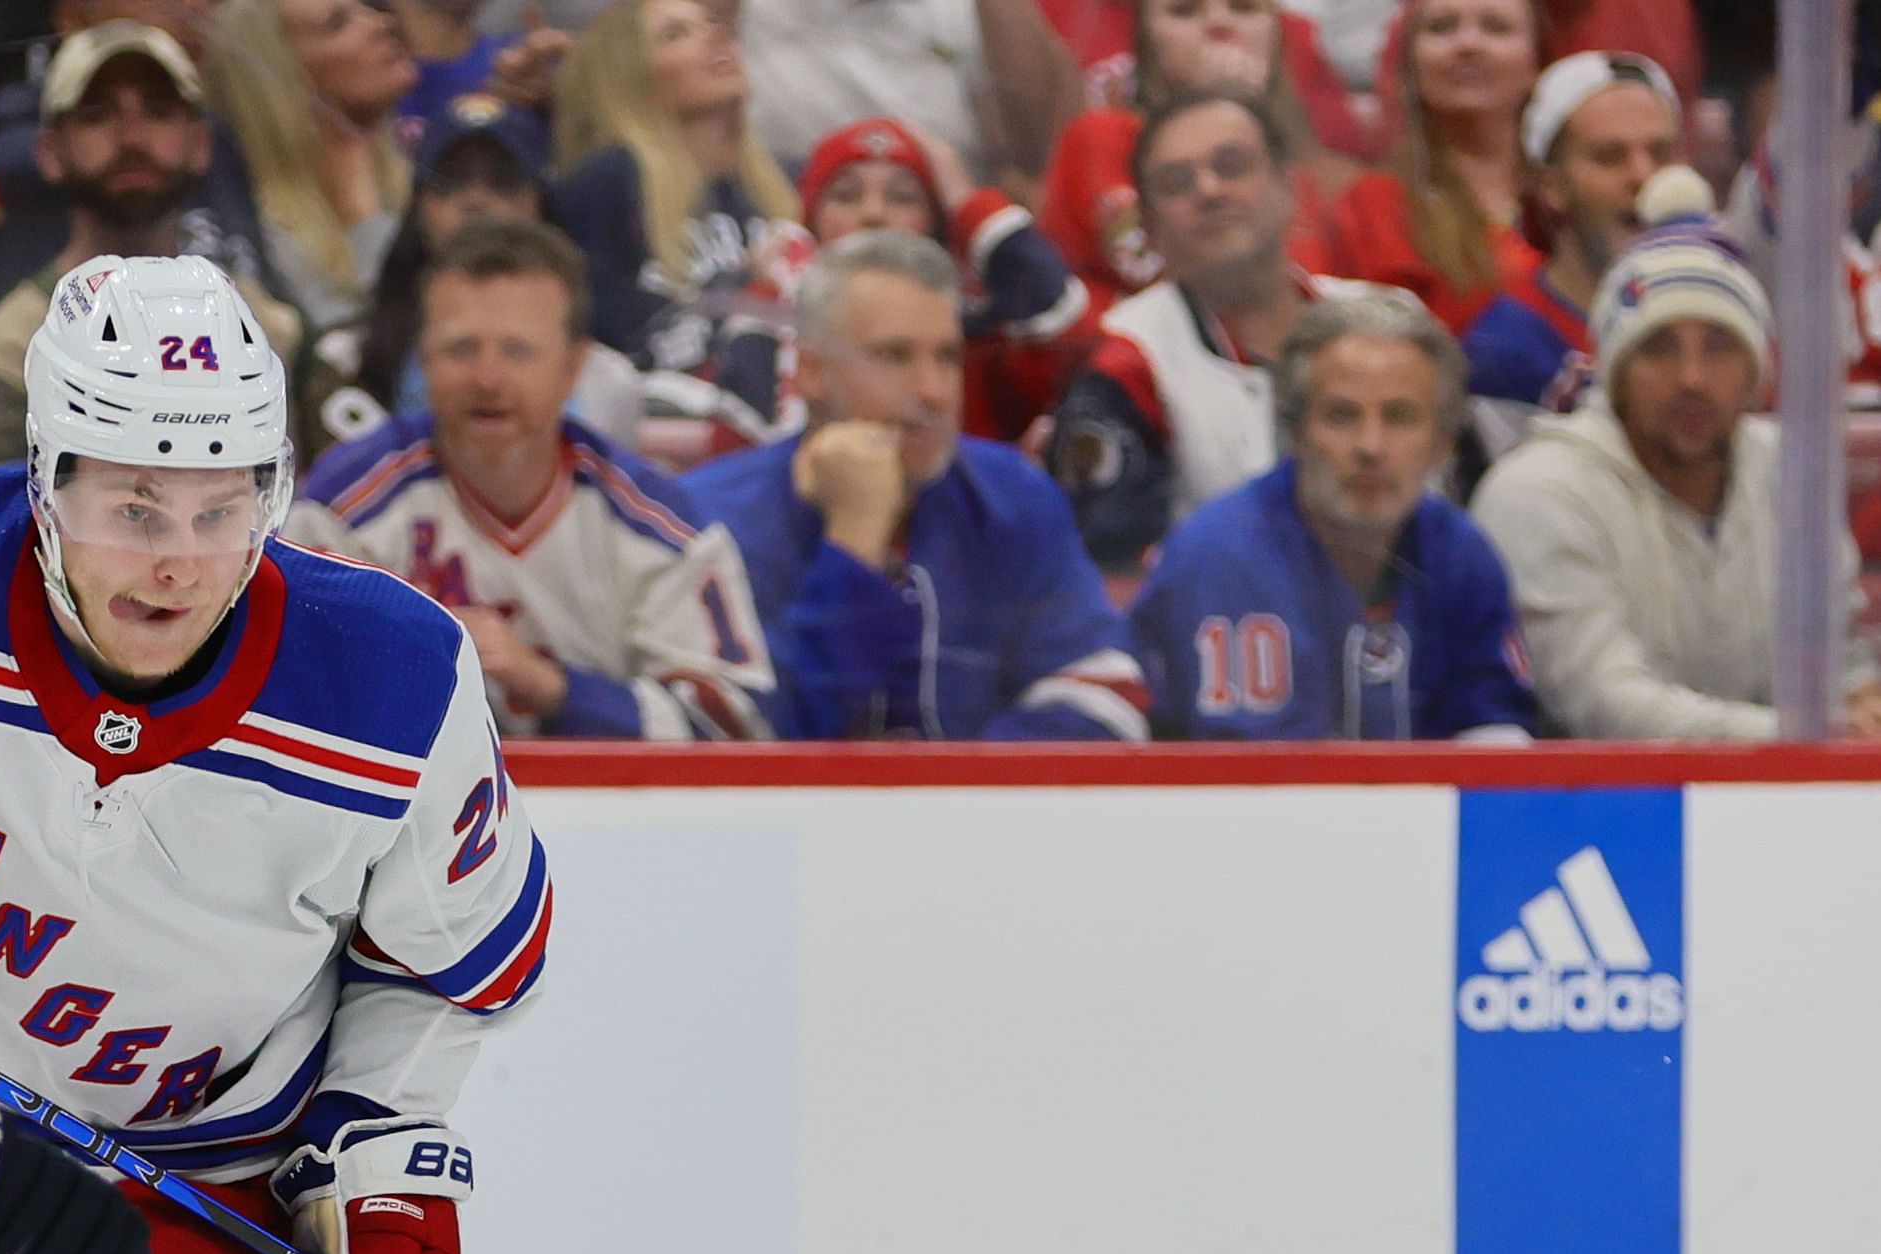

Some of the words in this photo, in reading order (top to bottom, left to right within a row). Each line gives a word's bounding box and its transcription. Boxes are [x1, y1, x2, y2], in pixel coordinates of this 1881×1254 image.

[159, 335, 220, 371] 24
[699, 572, 754, 666] 1
[1194, 612, 1295, 717] 10
[103, 727, 131, 742] NHL
[1458, 966, 1685, 1033] adidas
[367, 1200, 400, 1210] PRO
